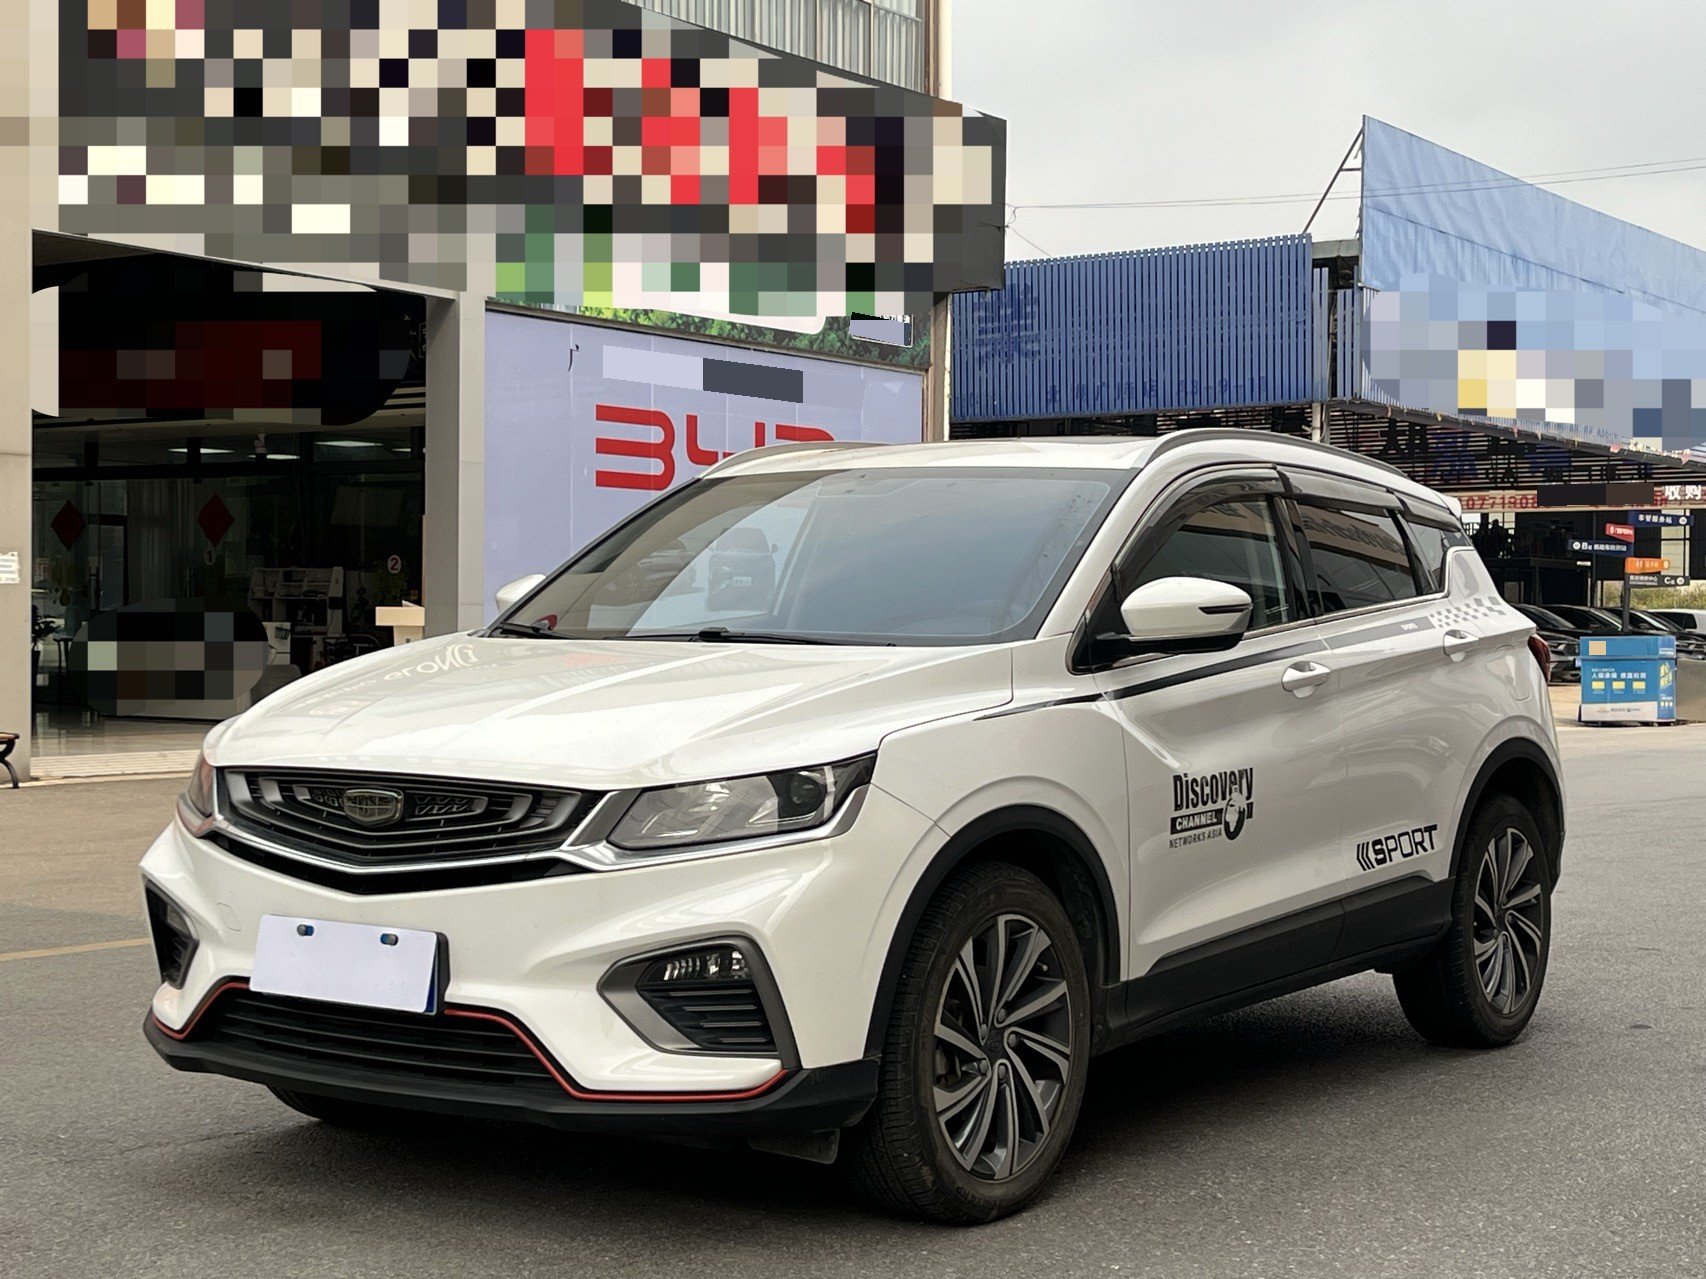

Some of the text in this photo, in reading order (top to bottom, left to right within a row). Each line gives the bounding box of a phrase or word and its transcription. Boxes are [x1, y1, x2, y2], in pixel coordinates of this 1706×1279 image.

[596, 404, 835, 491] BY
[390, 557, 399, 571] 2
[1173, 767, 1254, 812] Discovery
[1175, 811, 1218, 832] CHANNEL
[1169, 829, 1222, 849] NETWORKS ASIA
[1372, 824, 1438, 867] SPORT
